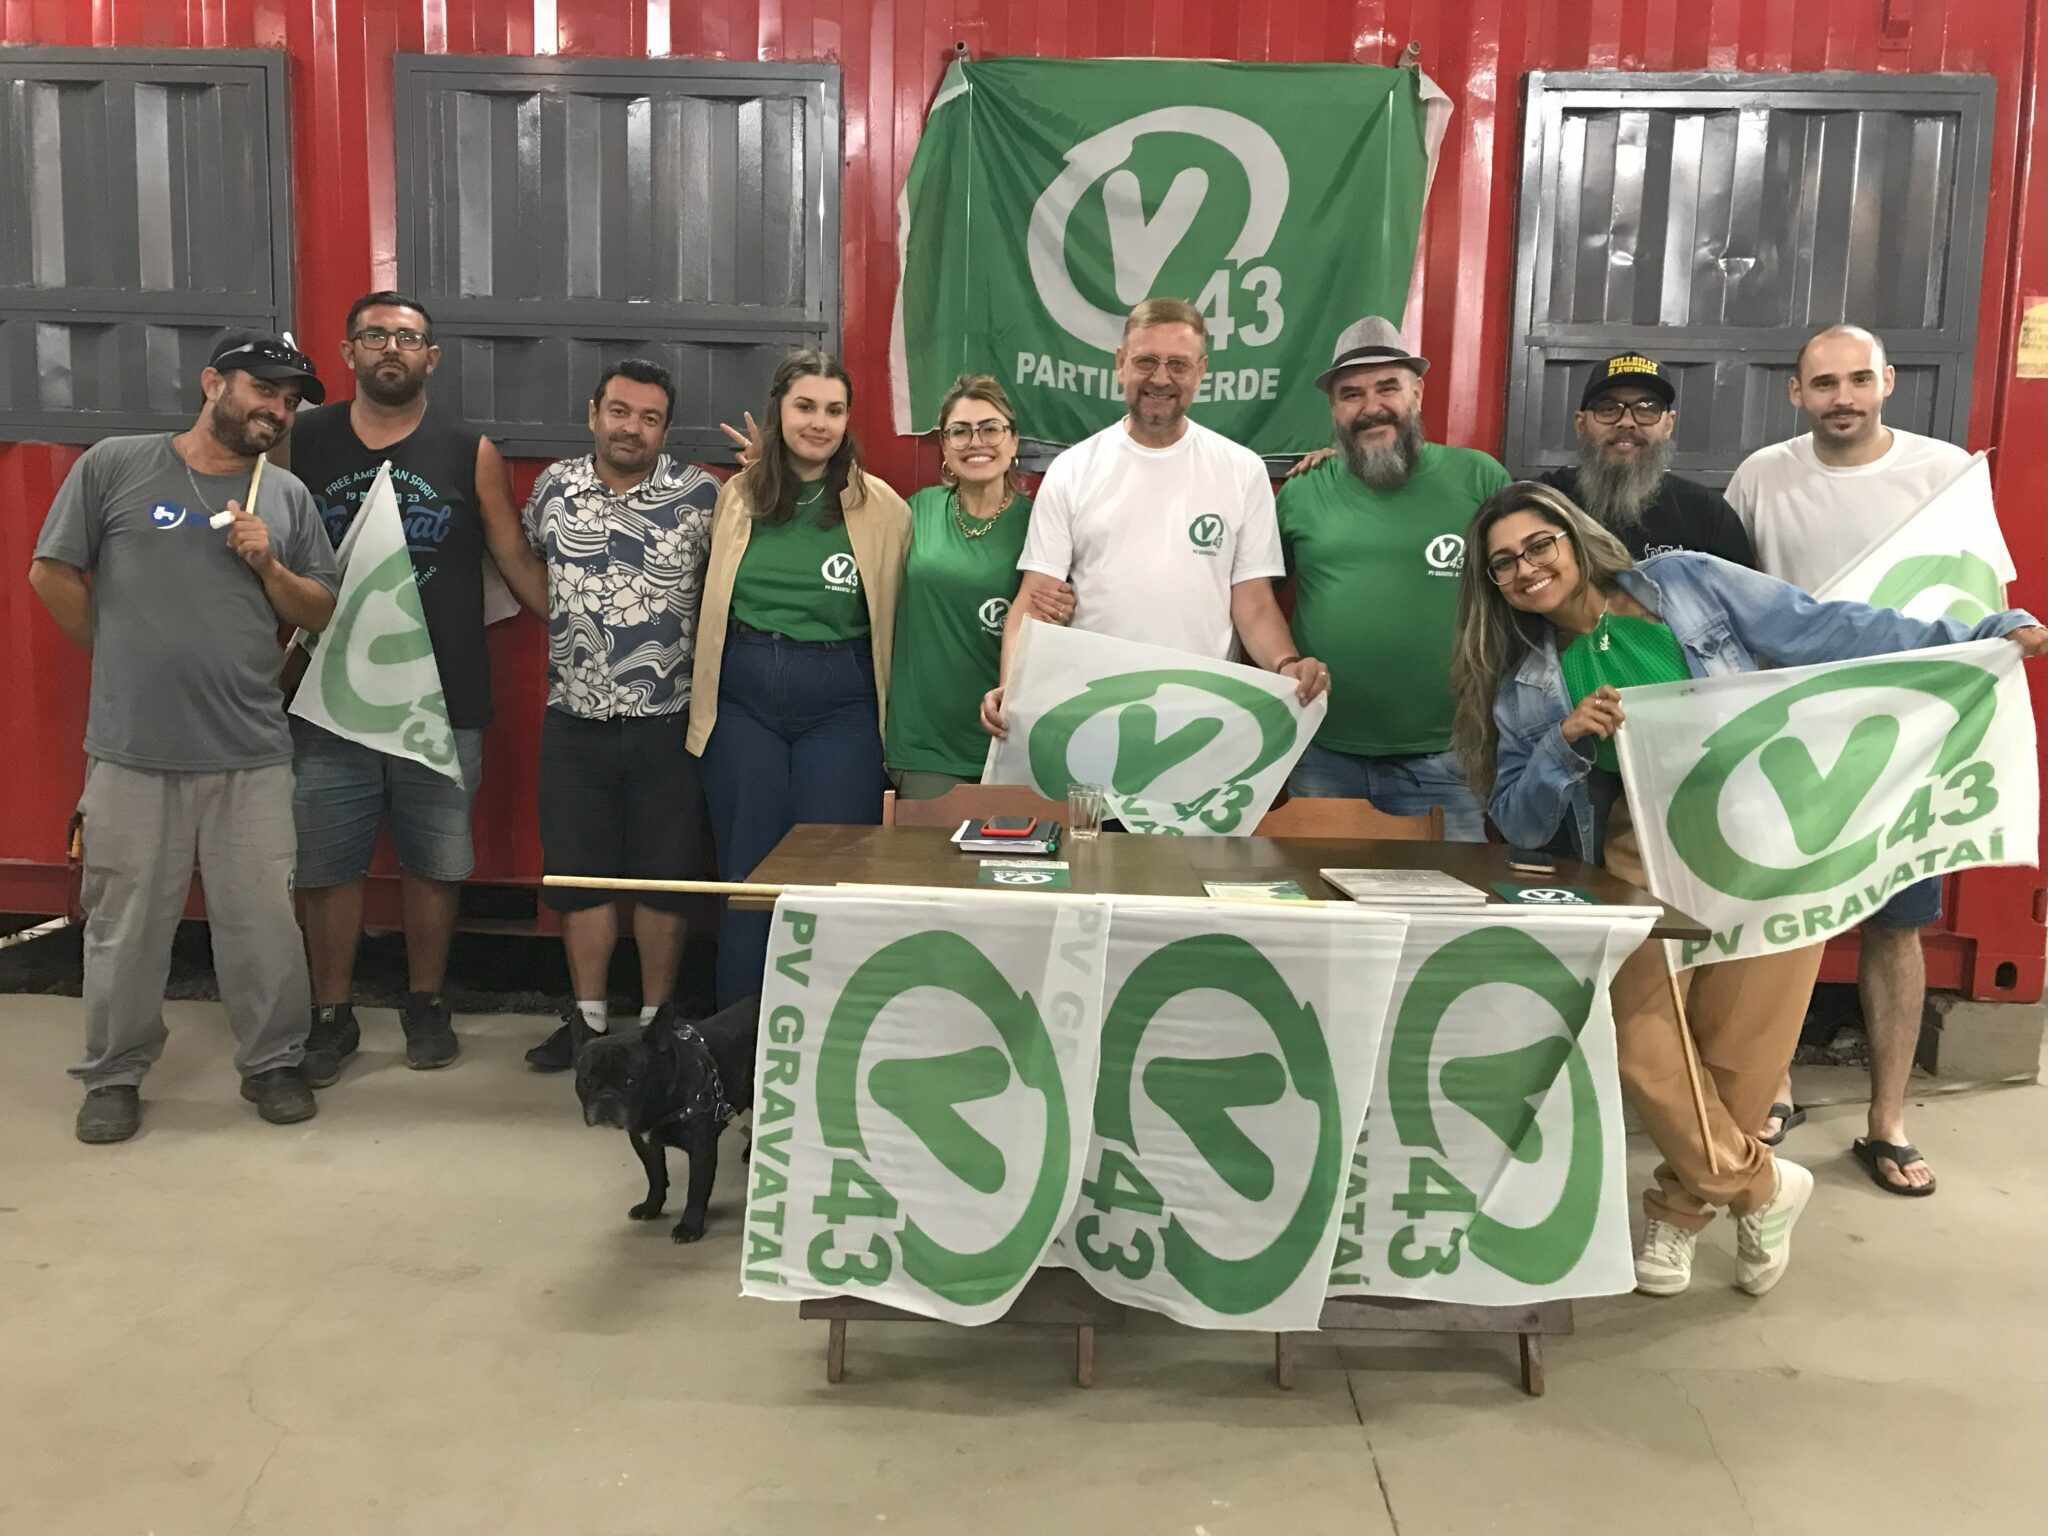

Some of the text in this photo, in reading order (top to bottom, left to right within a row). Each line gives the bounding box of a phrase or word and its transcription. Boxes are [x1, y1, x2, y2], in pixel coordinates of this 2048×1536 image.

[1194, 265, 1285, 351] 43
[1192, 368, 1281, 403] ERDE
[1609, 356, 1658, 371] HILLBILLY
[325, 475, 352, 496] FREE
[409, 474, 439, 500] SPIRIT
[346, 491, 357, 501] 19
[407, 493, 420, 503] 23
[845, 574, 858, 587] 43
[1450, 556, 1465, 569] 43
[1886, 760, 2000, 849] 43
[1681, 827, 2005, 966] PV GRAVATAÍ
[745, 910, 818, 1286] PV GRAVATAÍ
[806, 1158, 899, 1287] 43
[1075, 1148, 1165, 1281] 43
[1387, 1156, 1478, 1279] 43
